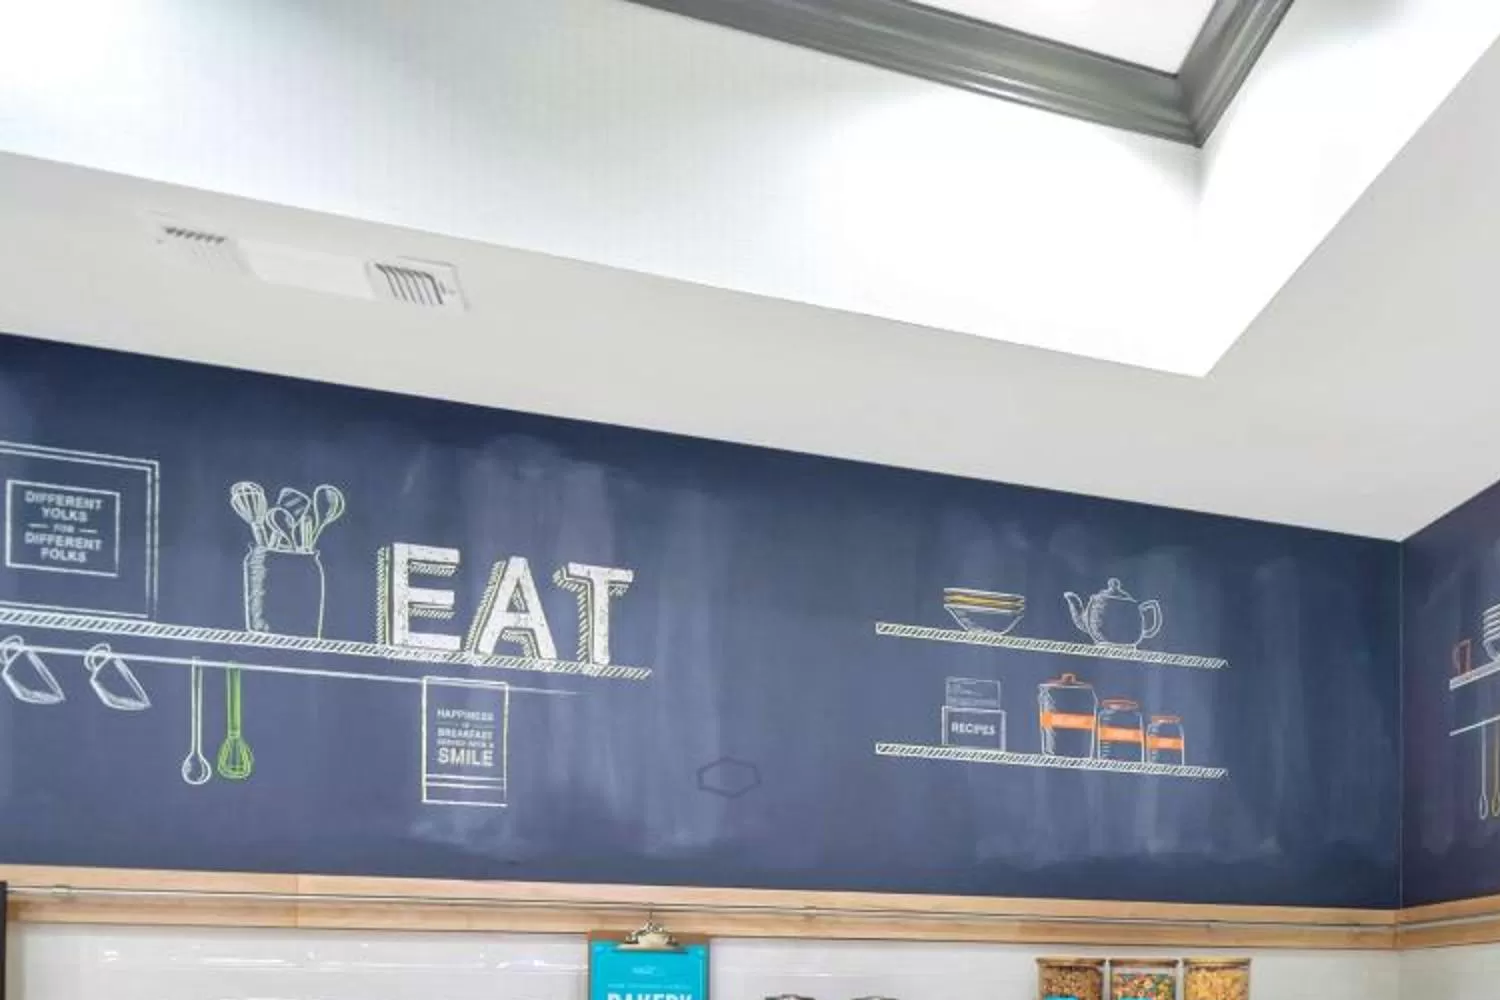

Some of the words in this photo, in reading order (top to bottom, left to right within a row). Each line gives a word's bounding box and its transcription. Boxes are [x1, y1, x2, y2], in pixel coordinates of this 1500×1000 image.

[24, 490, 102, 512] DIFFERENT
[42, 507, 88, 522] YOLKS
[24, 531, 102, 551] DIFFERENT
[41, 547, 87, 563] FOLKS
[377, 542, 635, 665] EAT
[951, 721, 996, 737] RECIPES
[438, 747, 494, 767] SMILE
